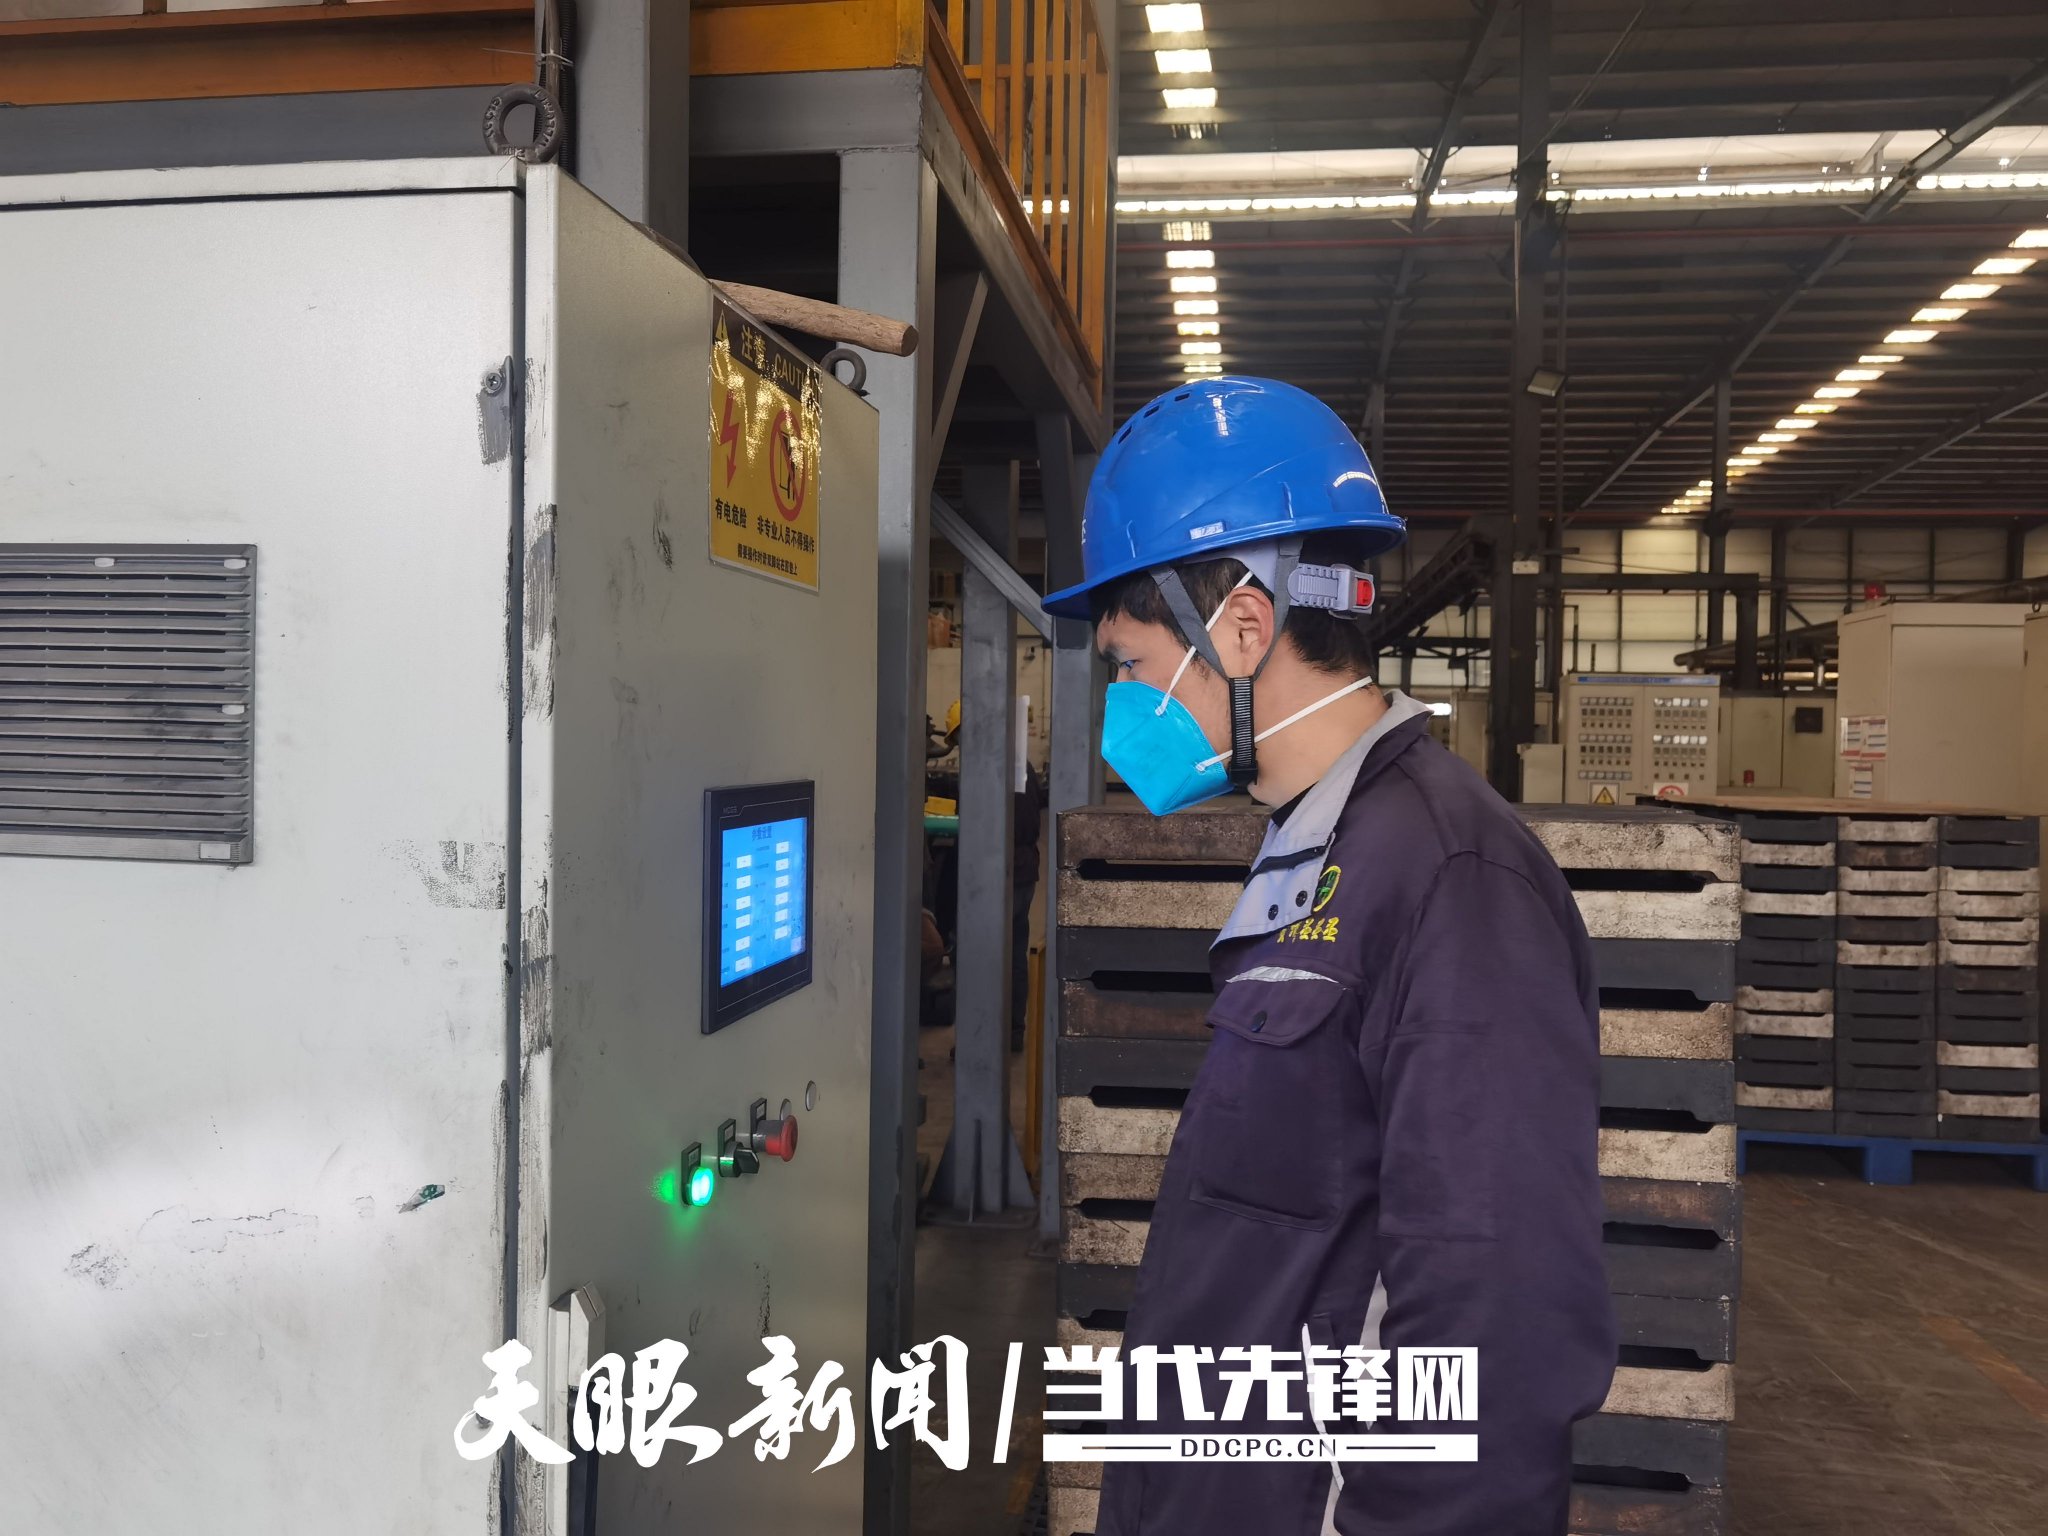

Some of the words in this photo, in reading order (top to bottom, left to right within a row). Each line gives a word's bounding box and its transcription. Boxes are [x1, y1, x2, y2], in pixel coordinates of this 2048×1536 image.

[774, 353, 820, 406] CAUTIN
[715, 497, 747, 528] 有电危险
[757, 515, 815, 555] 非专业人员不得操作
